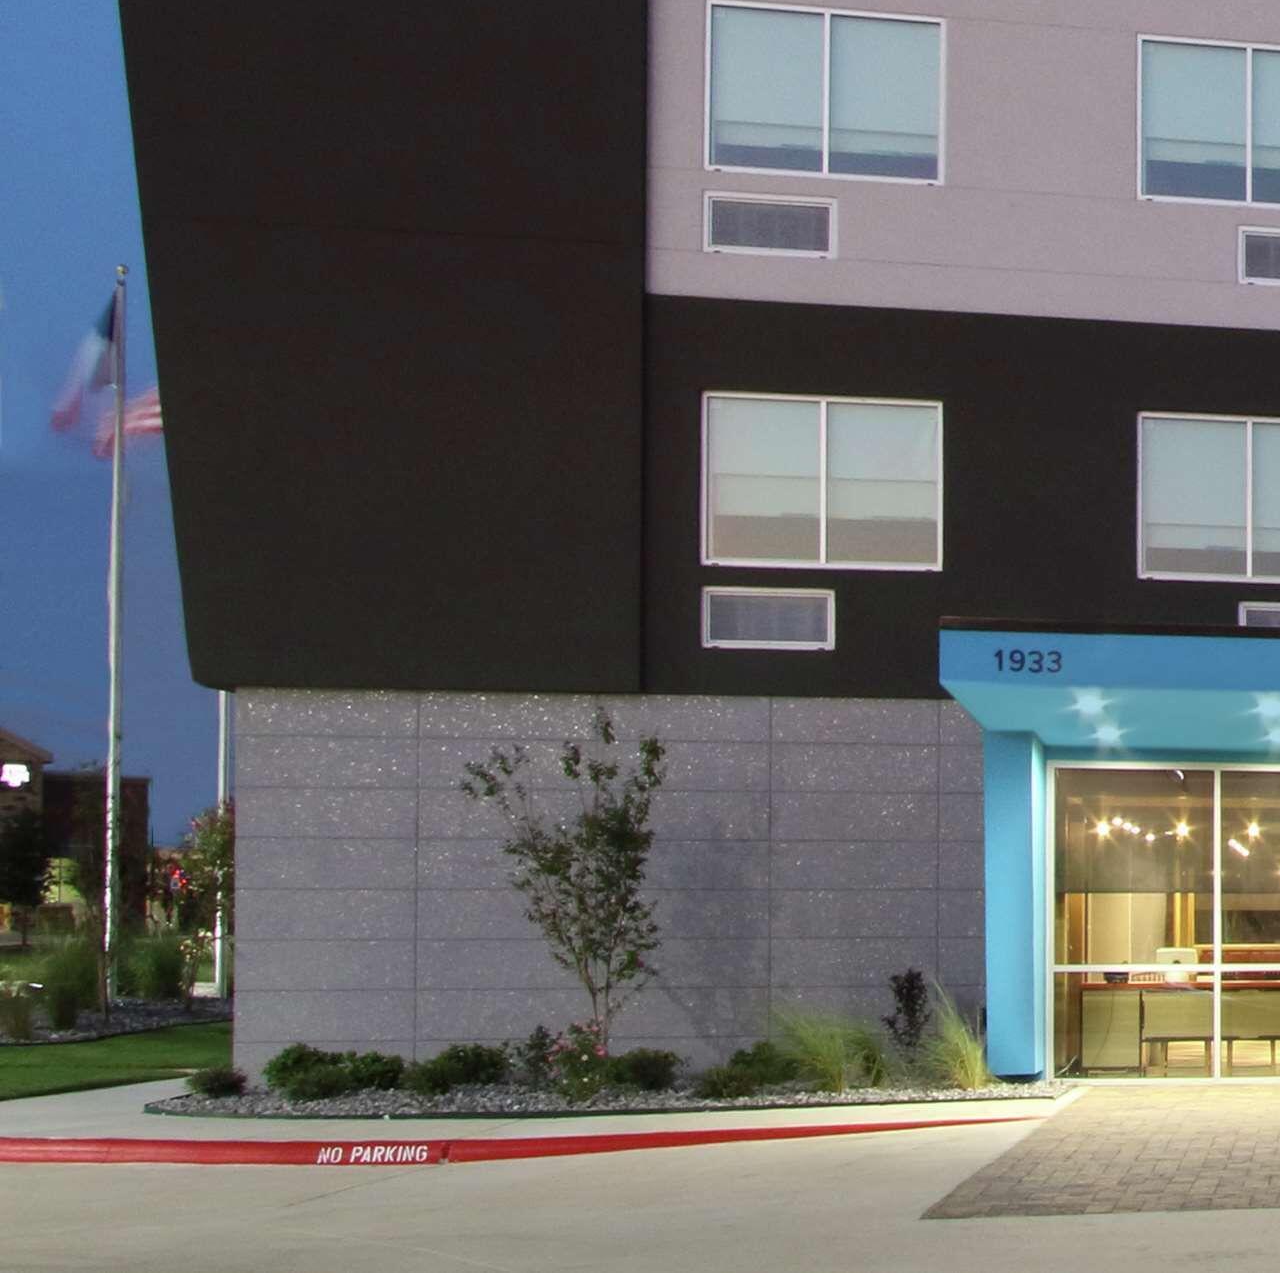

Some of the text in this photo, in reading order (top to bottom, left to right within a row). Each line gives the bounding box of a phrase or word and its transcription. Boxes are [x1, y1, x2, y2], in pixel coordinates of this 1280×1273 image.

[994, 649, 1062, 673] 1933
[316, 1145, 428, 1164] NO PARKING
